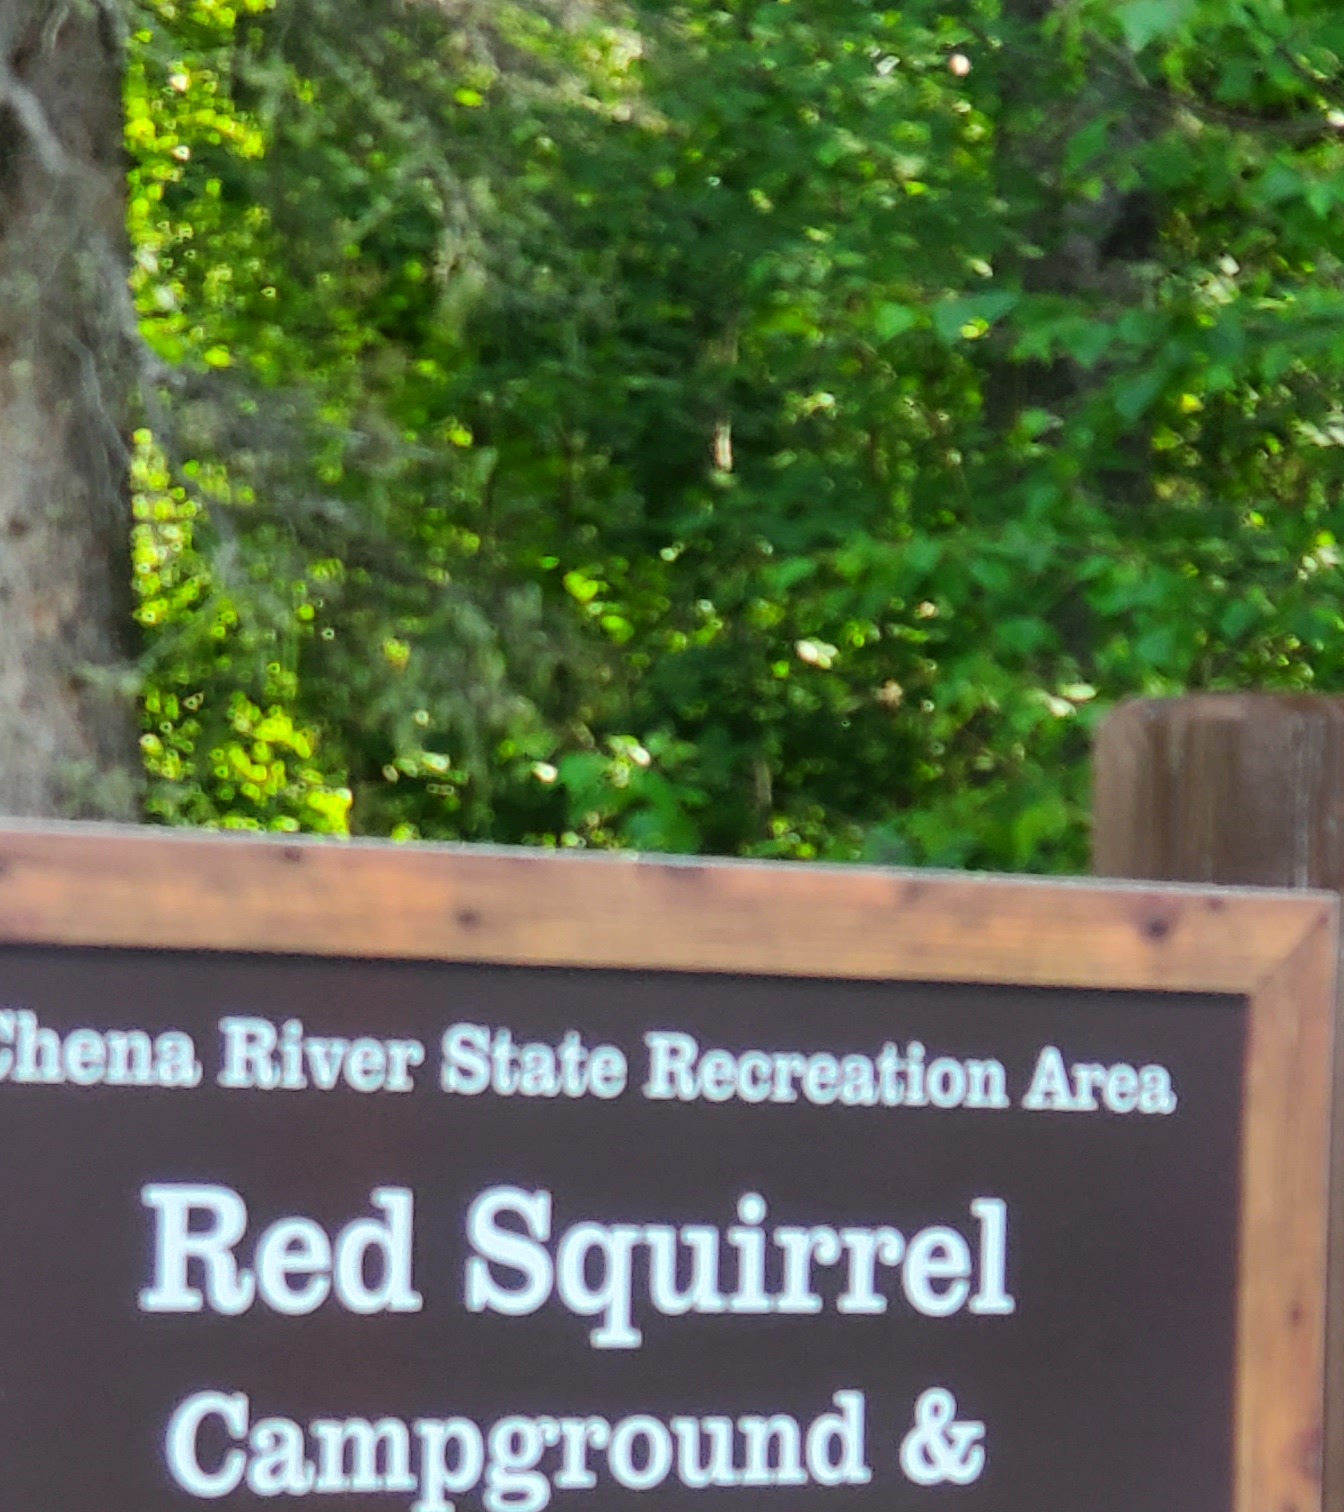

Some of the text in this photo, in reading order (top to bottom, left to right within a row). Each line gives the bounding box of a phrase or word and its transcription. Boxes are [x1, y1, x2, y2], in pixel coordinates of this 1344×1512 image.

[217, 1015, 426, 1093] River
[439, 1022, 628, 1099] State
[642, 1031, 1010, 1109] Recreation
[1022, 1045, 1178, 1115] Area
[139, 1183, 1015, 1349] Red Squirrel
[899, 1387, 987, 1487] &
